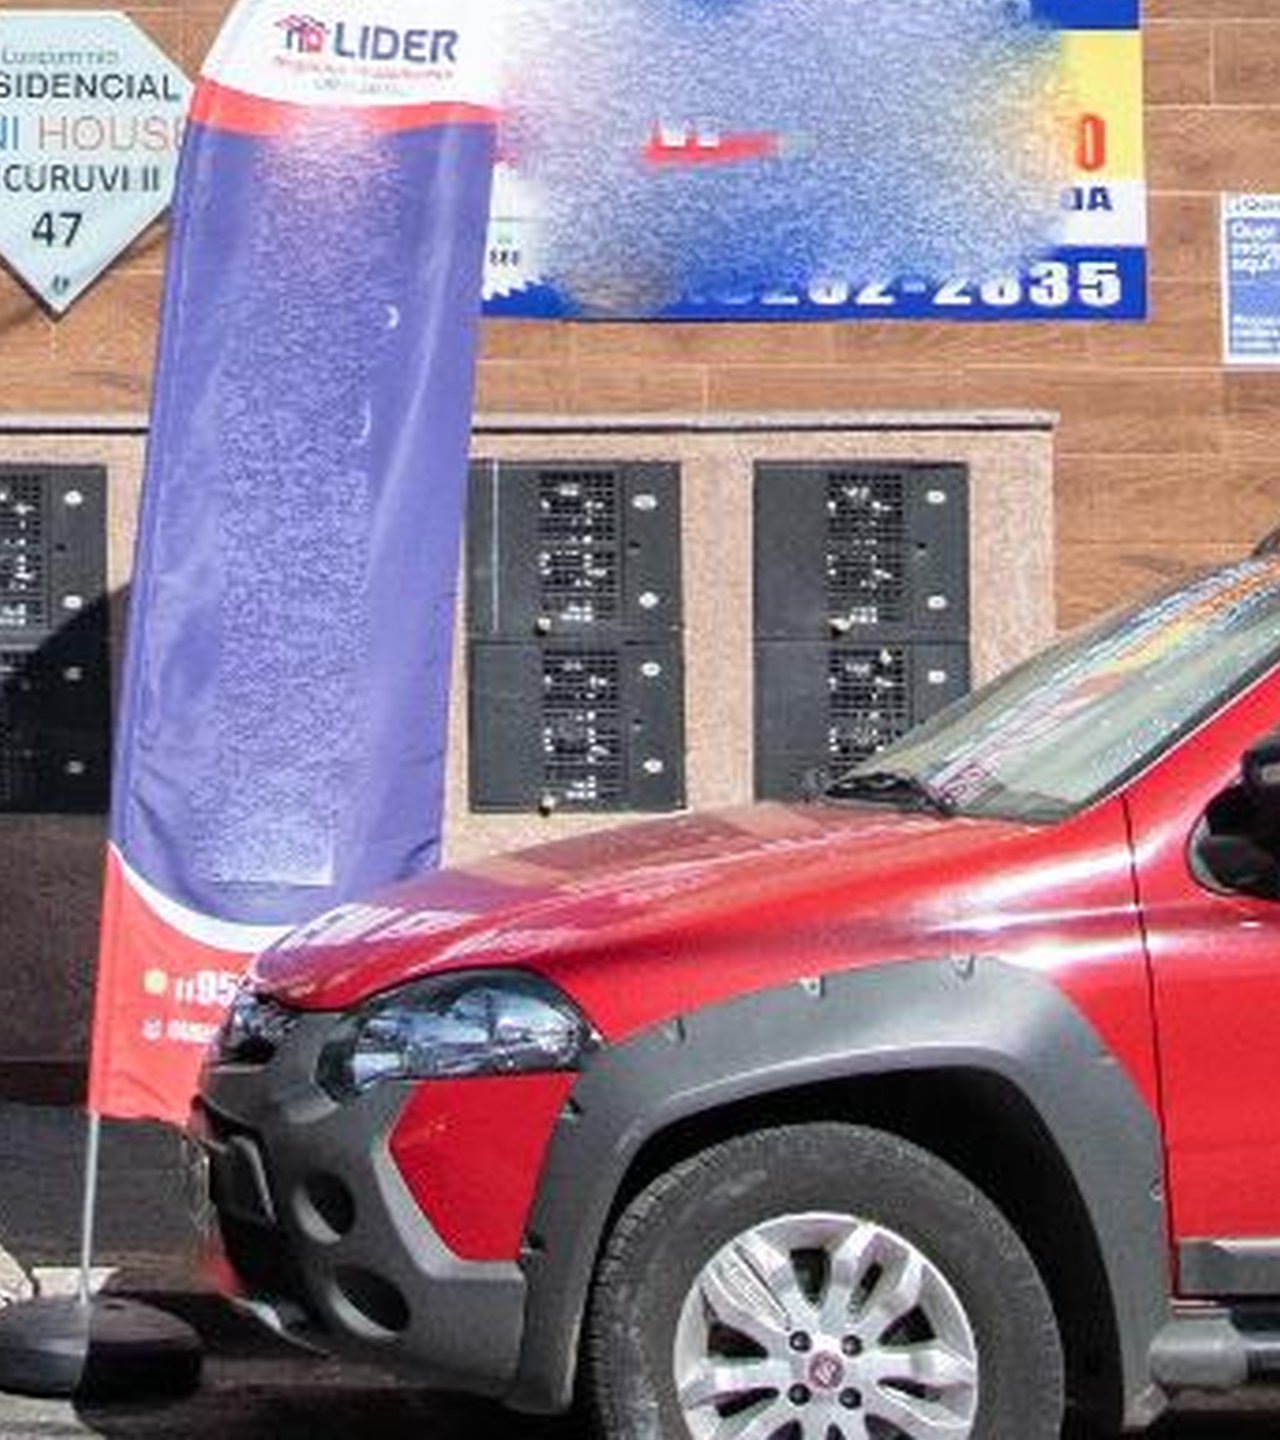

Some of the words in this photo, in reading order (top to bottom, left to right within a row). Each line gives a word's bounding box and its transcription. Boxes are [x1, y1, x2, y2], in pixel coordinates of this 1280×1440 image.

[334, 21, 460, 64] LIDER
[38, 115, 184, 152] HOUS
[31, 211, 83, 248] 47
